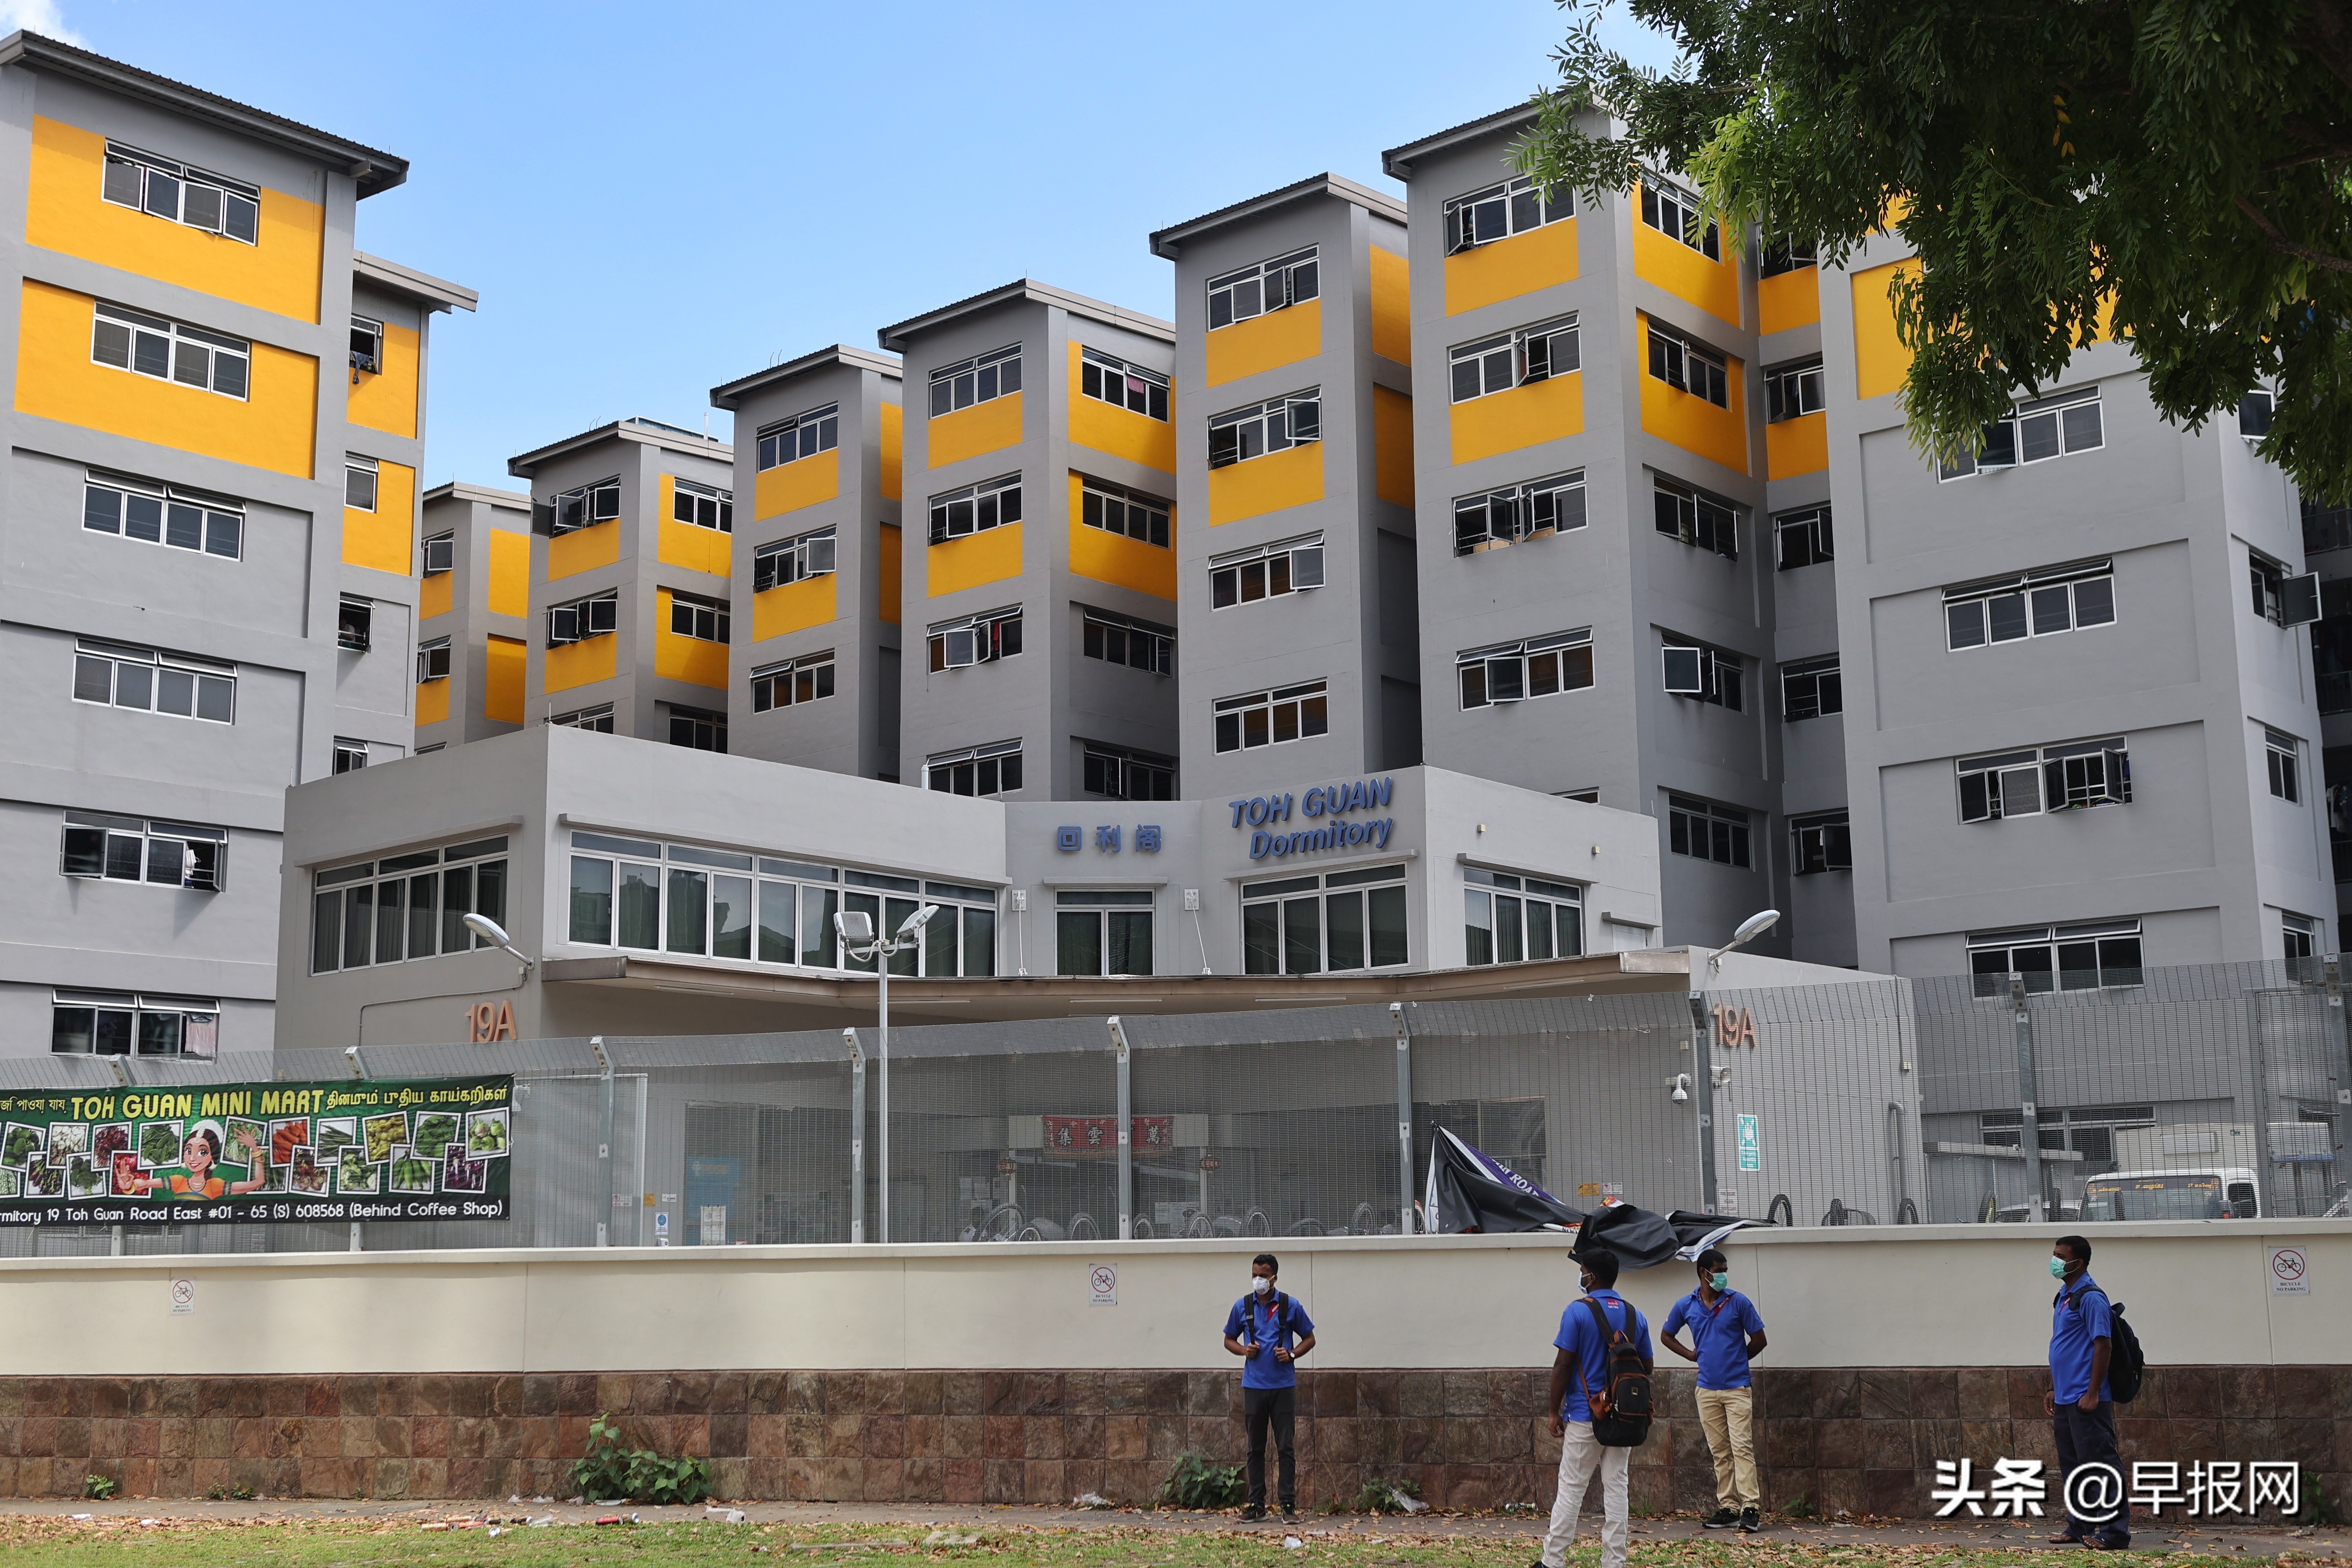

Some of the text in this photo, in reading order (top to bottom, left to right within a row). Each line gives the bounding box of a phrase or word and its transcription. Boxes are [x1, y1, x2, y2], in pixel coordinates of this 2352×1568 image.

[1228, 777, 1393, 829] TOH GUAN
[1057, 824, 1162, 853] 回利阁
[1250, 818, 1393, 860] Dormitory
[465, 1000, 518, 1043] 19A
[1710, 1003, 1756, 1047] 19A
[71, 1089, 324, 1120] TOH GUAN MINI MART
[326, 1084, 507, 1110] தினமும் புதிய காய்கறிகள்
[47, 1208, 59, 1222] 19
[65, 1207, 88, 1221] Toh
[94, 1207, 124, 1221] Guan
[130, 1207, 168, 1220] Road
[174, 1207, 202, 1220] East
[208, 1205, 232, 1219] #01
[251, 1205, 267, 1218] 65
[273, 1203, 290, 1219] (S)
[295, 1204, 344, 1218] 608568
[349, 1202, 401, 1218] (Behind
[407, 1201, 456, 1217] Coffee
[463, 1200, 502, 1218] Shop)
